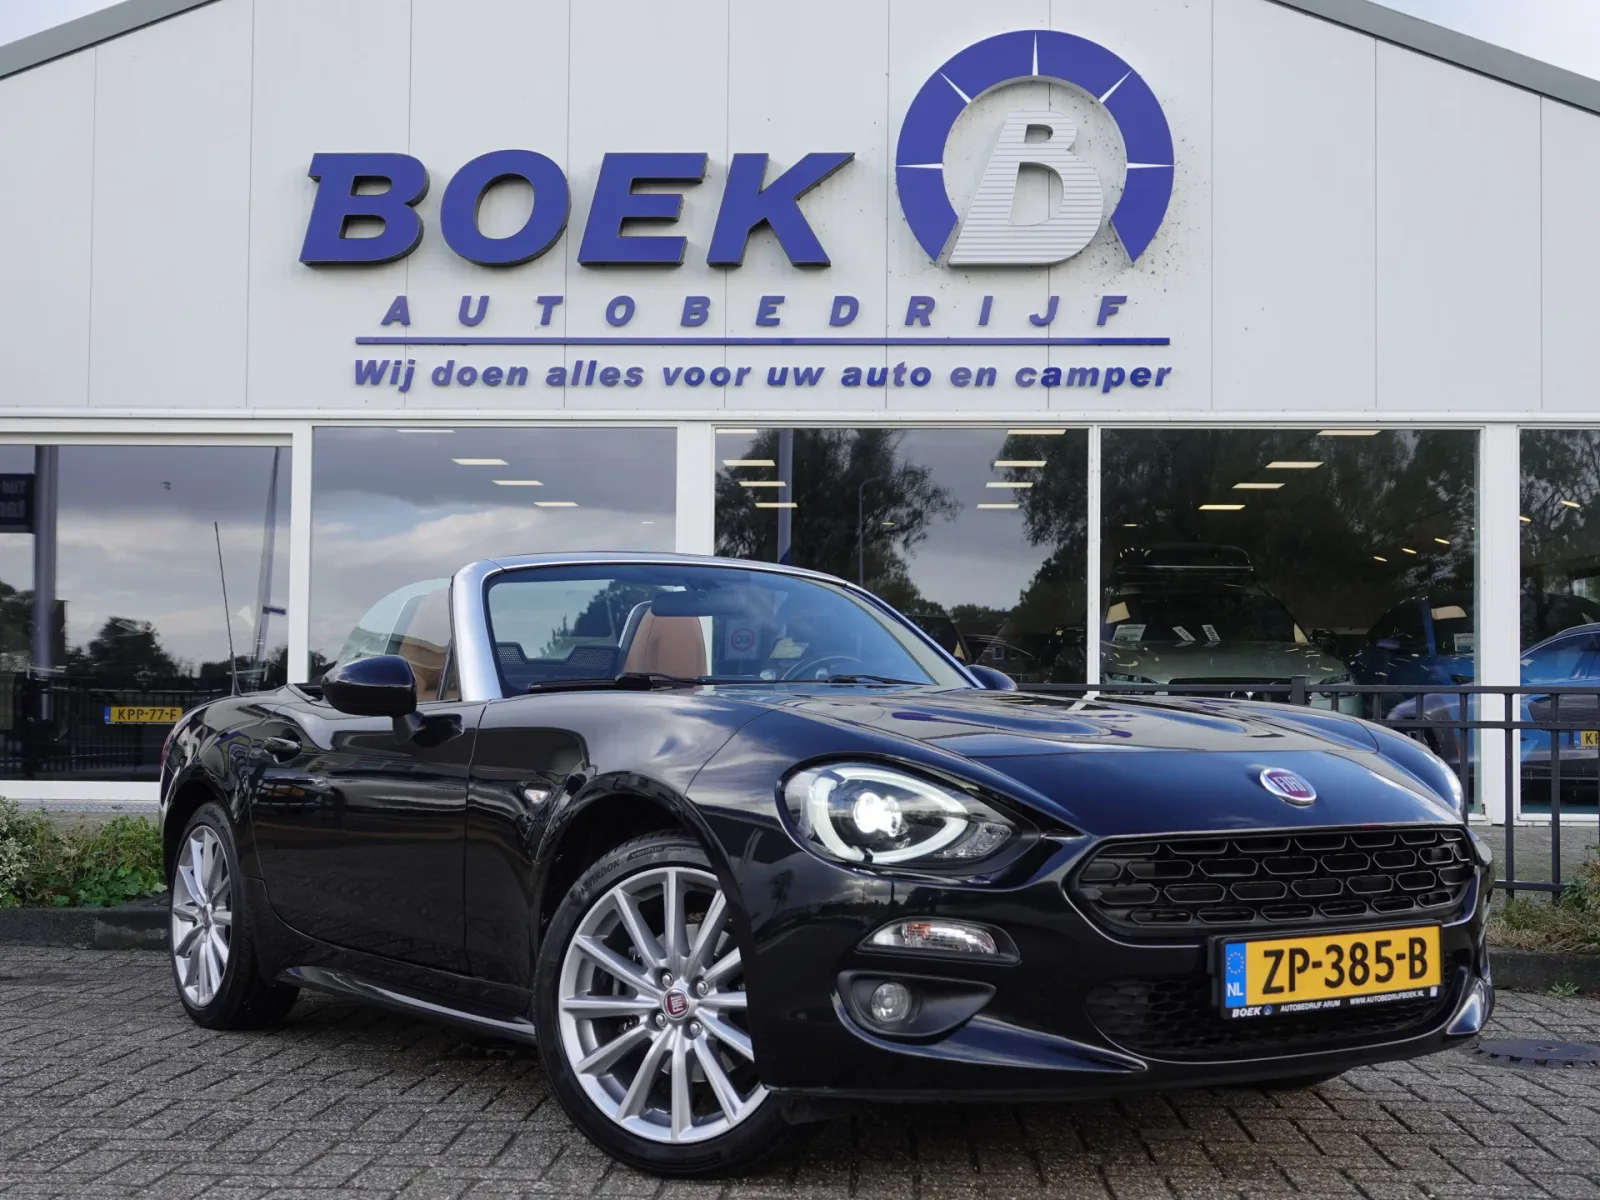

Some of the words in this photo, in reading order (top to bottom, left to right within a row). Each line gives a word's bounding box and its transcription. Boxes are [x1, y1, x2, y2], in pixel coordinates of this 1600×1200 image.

[299, 150, 852, 267] BOEK
[381, 295, 1128, 327] AUTOBEDRIJF
[354, 358, 416, 393] Wij
[431, 359, 529, 386] doen
[545, 359, 643, 387] alles
[661, 366, 752, 387] voor
[766, 366, 825, 387] uw
[840, 362, 932, 388] auto
[949, 367, 998, 387] en
[1014, 365, 1173, 394] camper
[118, 708, 177, 721] KPP-77-F
[1227, 982, 1244, 997] NL
[1262, 936, 1429, 995] ZP-385-B
[1232, 1006, 1263, 1018] BOEK
[1280, 1001, 1323, 1013] AUTOBEDRIJF
[1323, 999, 1341, 1009] ARUM
